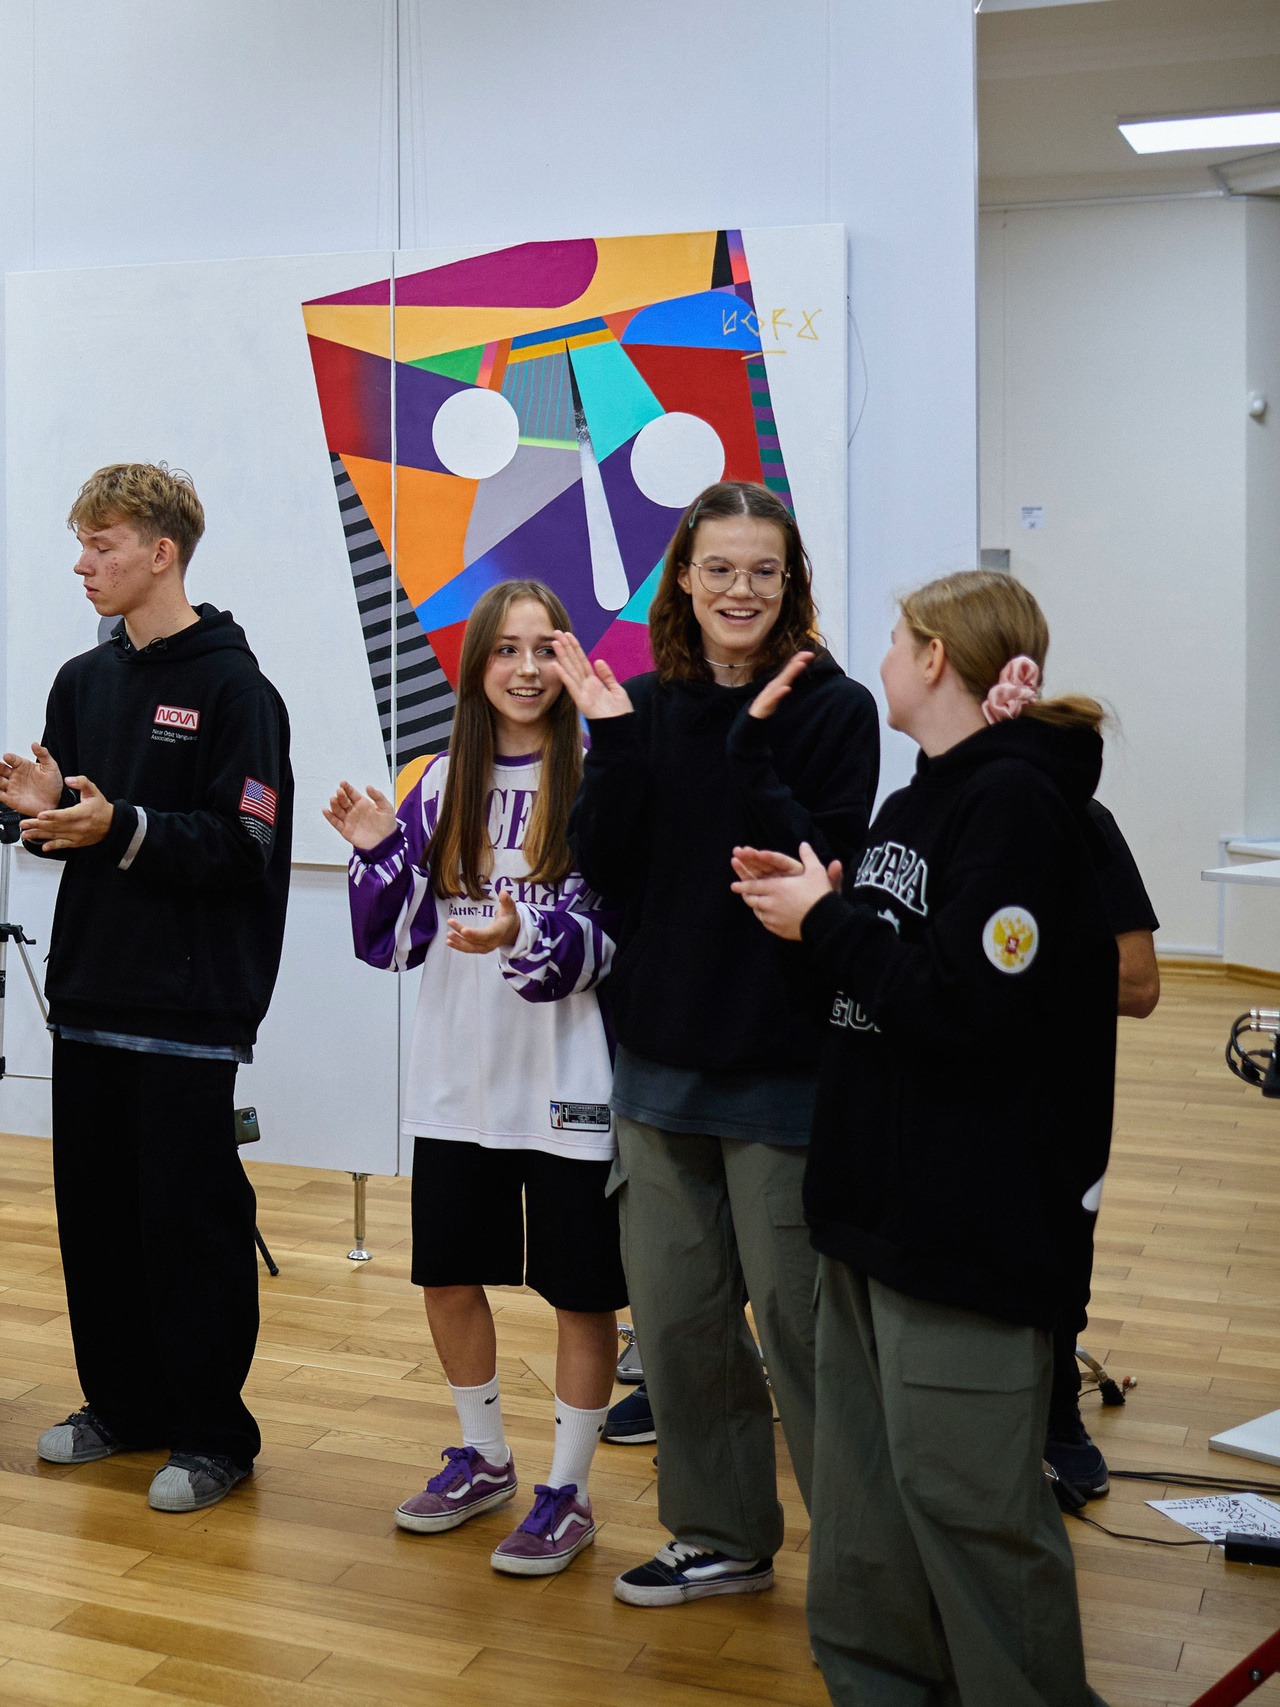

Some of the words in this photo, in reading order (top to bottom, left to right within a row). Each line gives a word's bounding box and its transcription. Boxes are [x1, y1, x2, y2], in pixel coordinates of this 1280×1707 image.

[157, 709, 196, 726] NOVA
[150, 734, 176, 743] Association
[163, 730, 175, 738] Orbit
